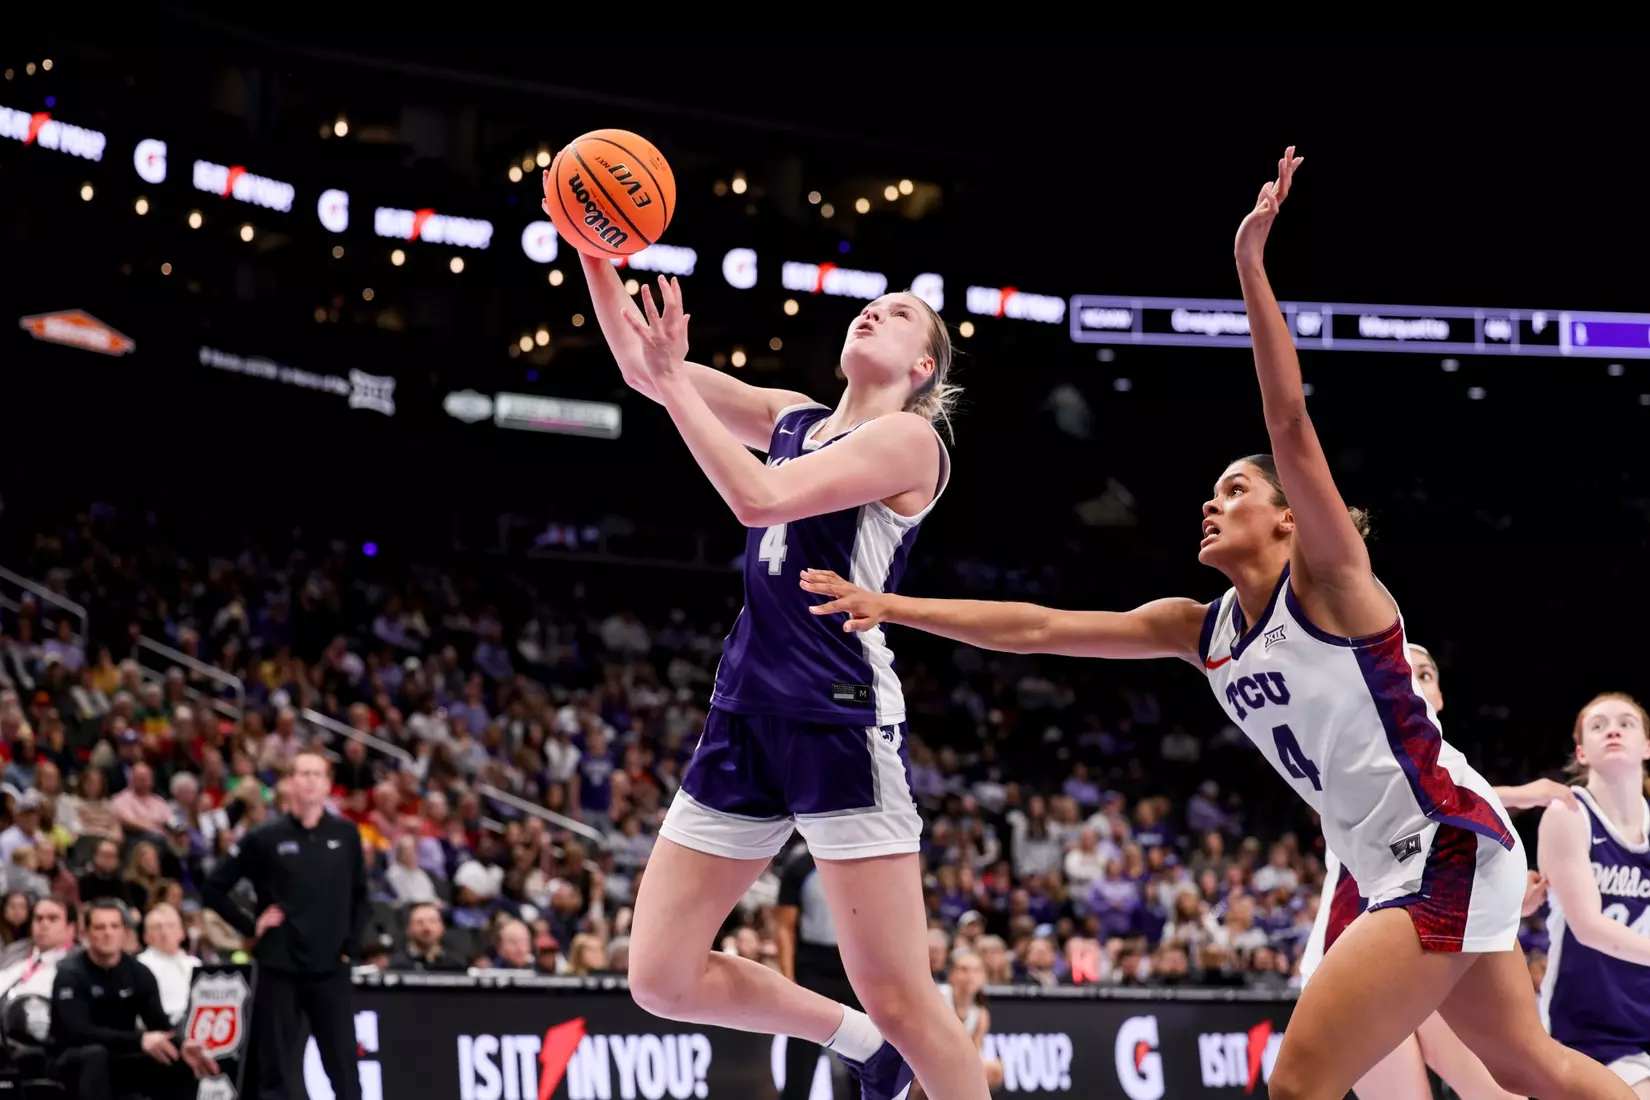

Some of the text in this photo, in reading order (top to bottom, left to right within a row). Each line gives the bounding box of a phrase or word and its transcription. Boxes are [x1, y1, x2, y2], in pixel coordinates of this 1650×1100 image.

[568, 173, 628, 248] Wilson
[608, 163, 652, 208] EVO
[758, 522, 788, 576] 4
[859, 688, 867, 698] M
[1225, 671, 1291, 722] TCU
[1271, 723, 1323, 792] 4
[197, 1009, 232, 1042] 66
[457, 1033, 502, 1100] IS
[500, 1034, 541, 1100] IT
[608, 1032, 712, 1100] YOU?
[996, 1032, 1073, 1092] YOU?
[1115, 1014, 1165, 1100] G
